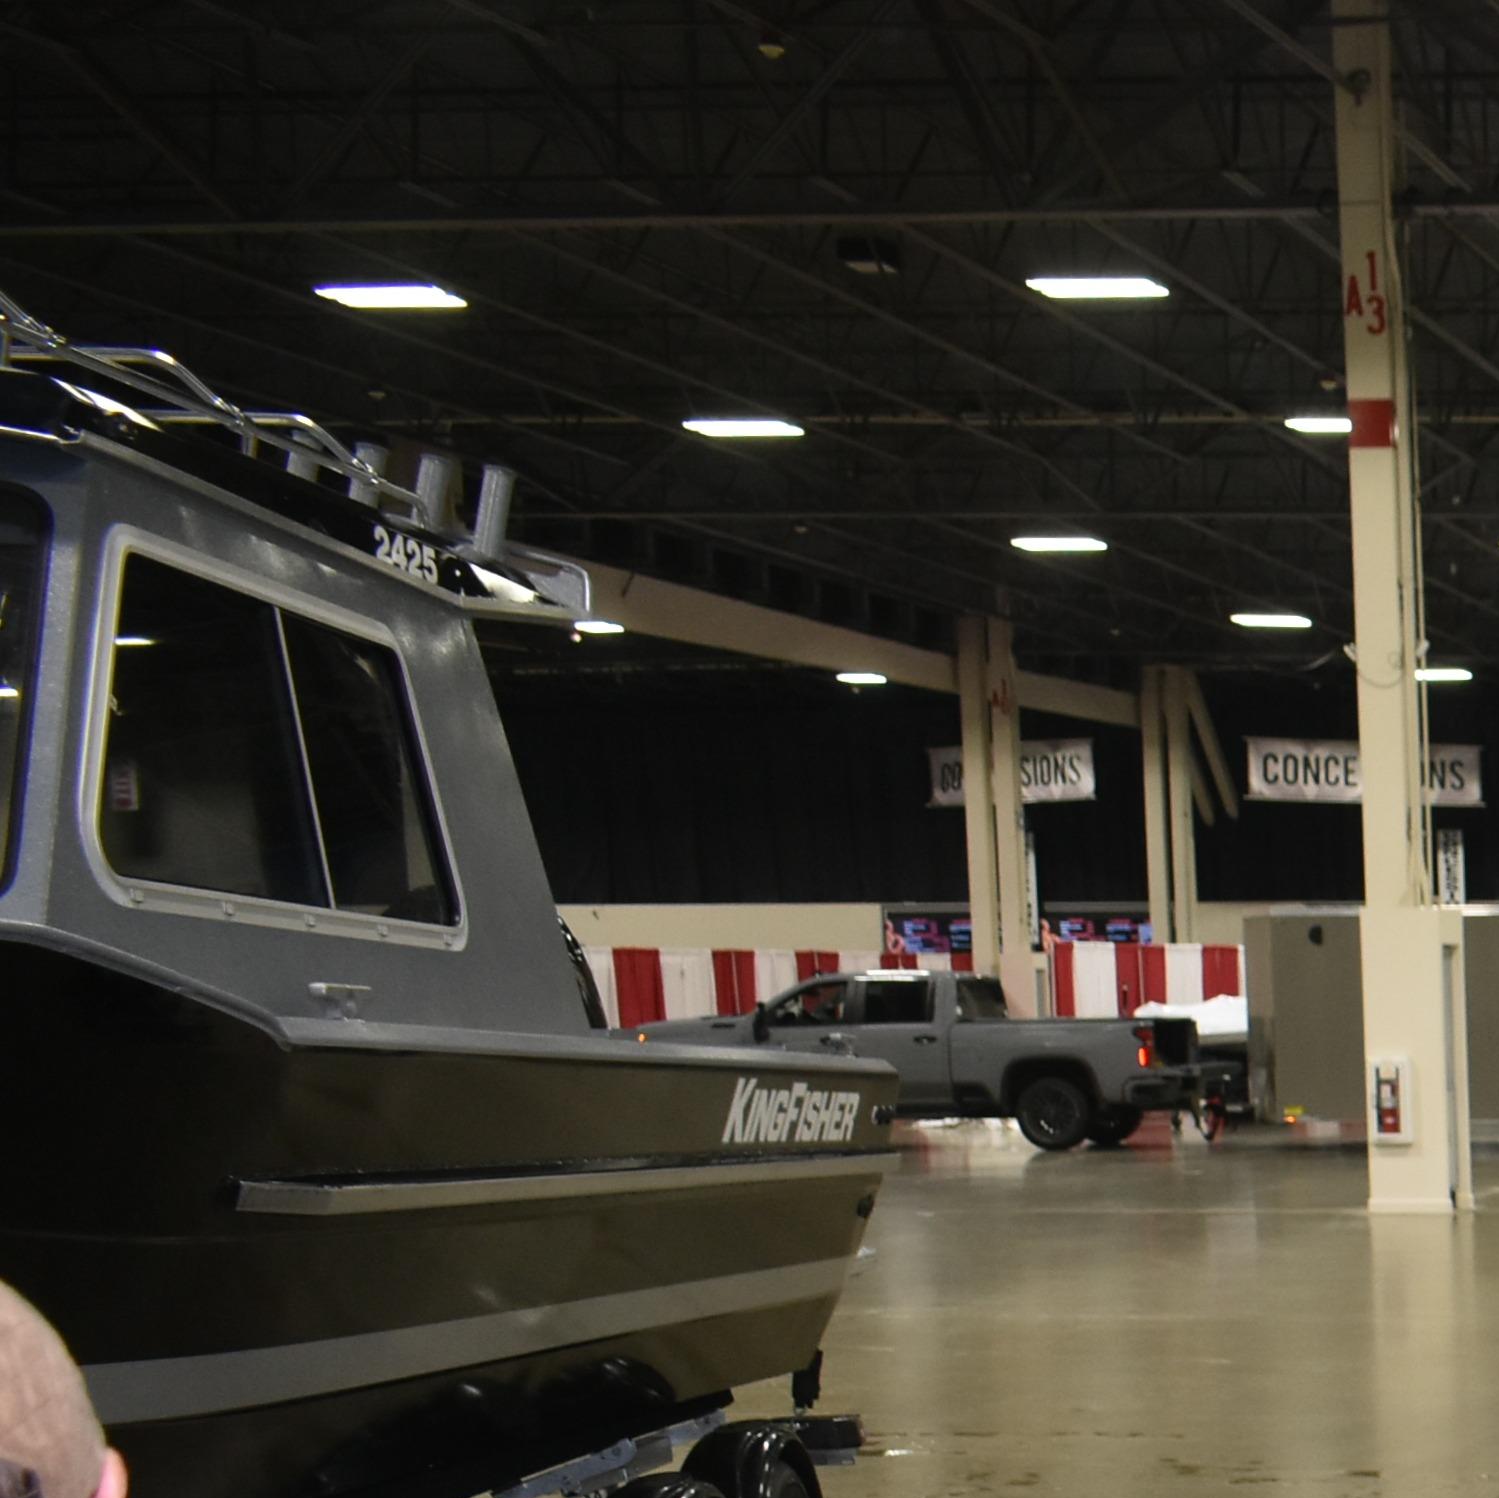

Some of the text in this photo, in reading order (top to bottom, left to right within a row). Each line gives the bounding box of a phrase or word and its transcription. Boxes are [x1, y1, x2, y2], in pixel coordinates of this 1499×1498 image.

[373, 525, 438, 584] 2425
[940, 752, 1081, 793] COSIONS
[1262, 752, 1465, 791] CONCENS
